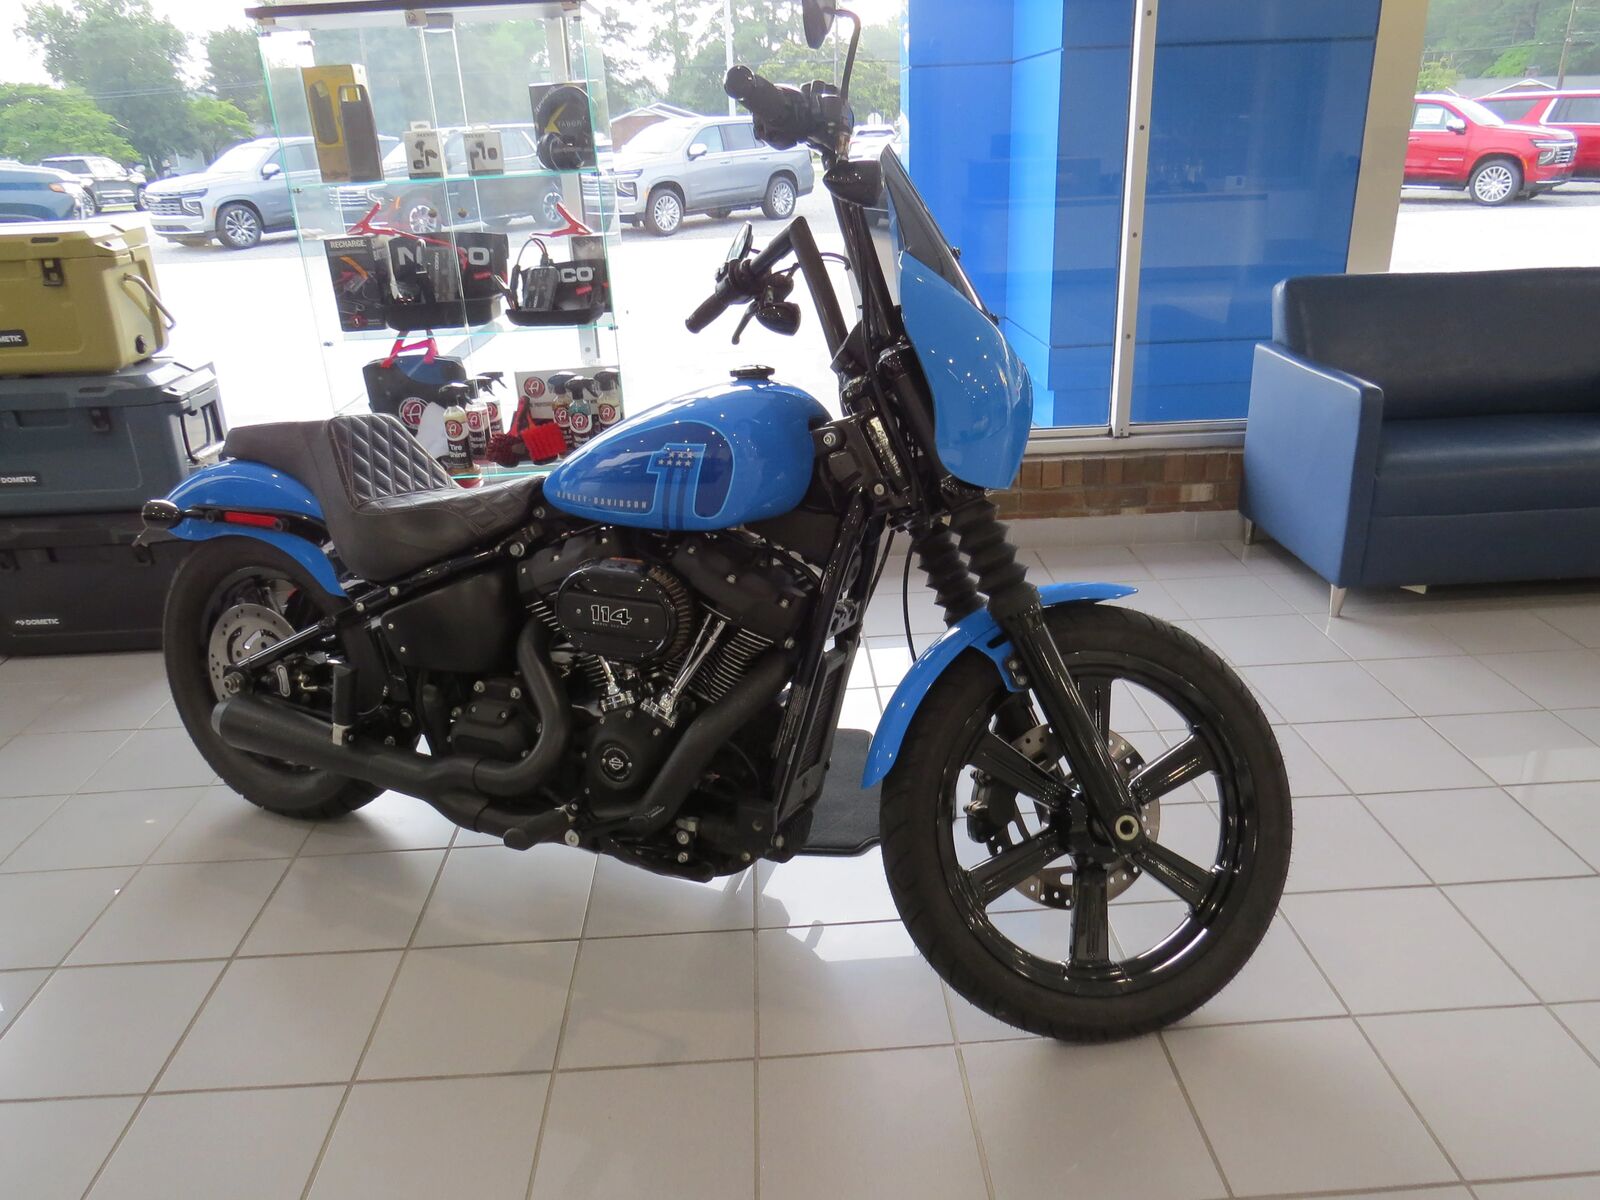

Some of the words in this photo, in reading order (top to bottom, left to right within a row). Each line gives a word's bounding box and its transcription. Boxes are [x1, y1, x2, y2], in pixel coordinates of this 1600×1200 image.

[329, 239, 366, 249] RECHARGE
[397, 246, 490, 266] NO
[450, 443, 463, 451] Tire
[1, 476, 37, 484] DOMETIC
[556, 491, 648, 510] HARLEY-DAVIDSON
[590, 604, 633, 626] 114
[25, 618, 60, 626] DOMETIC
